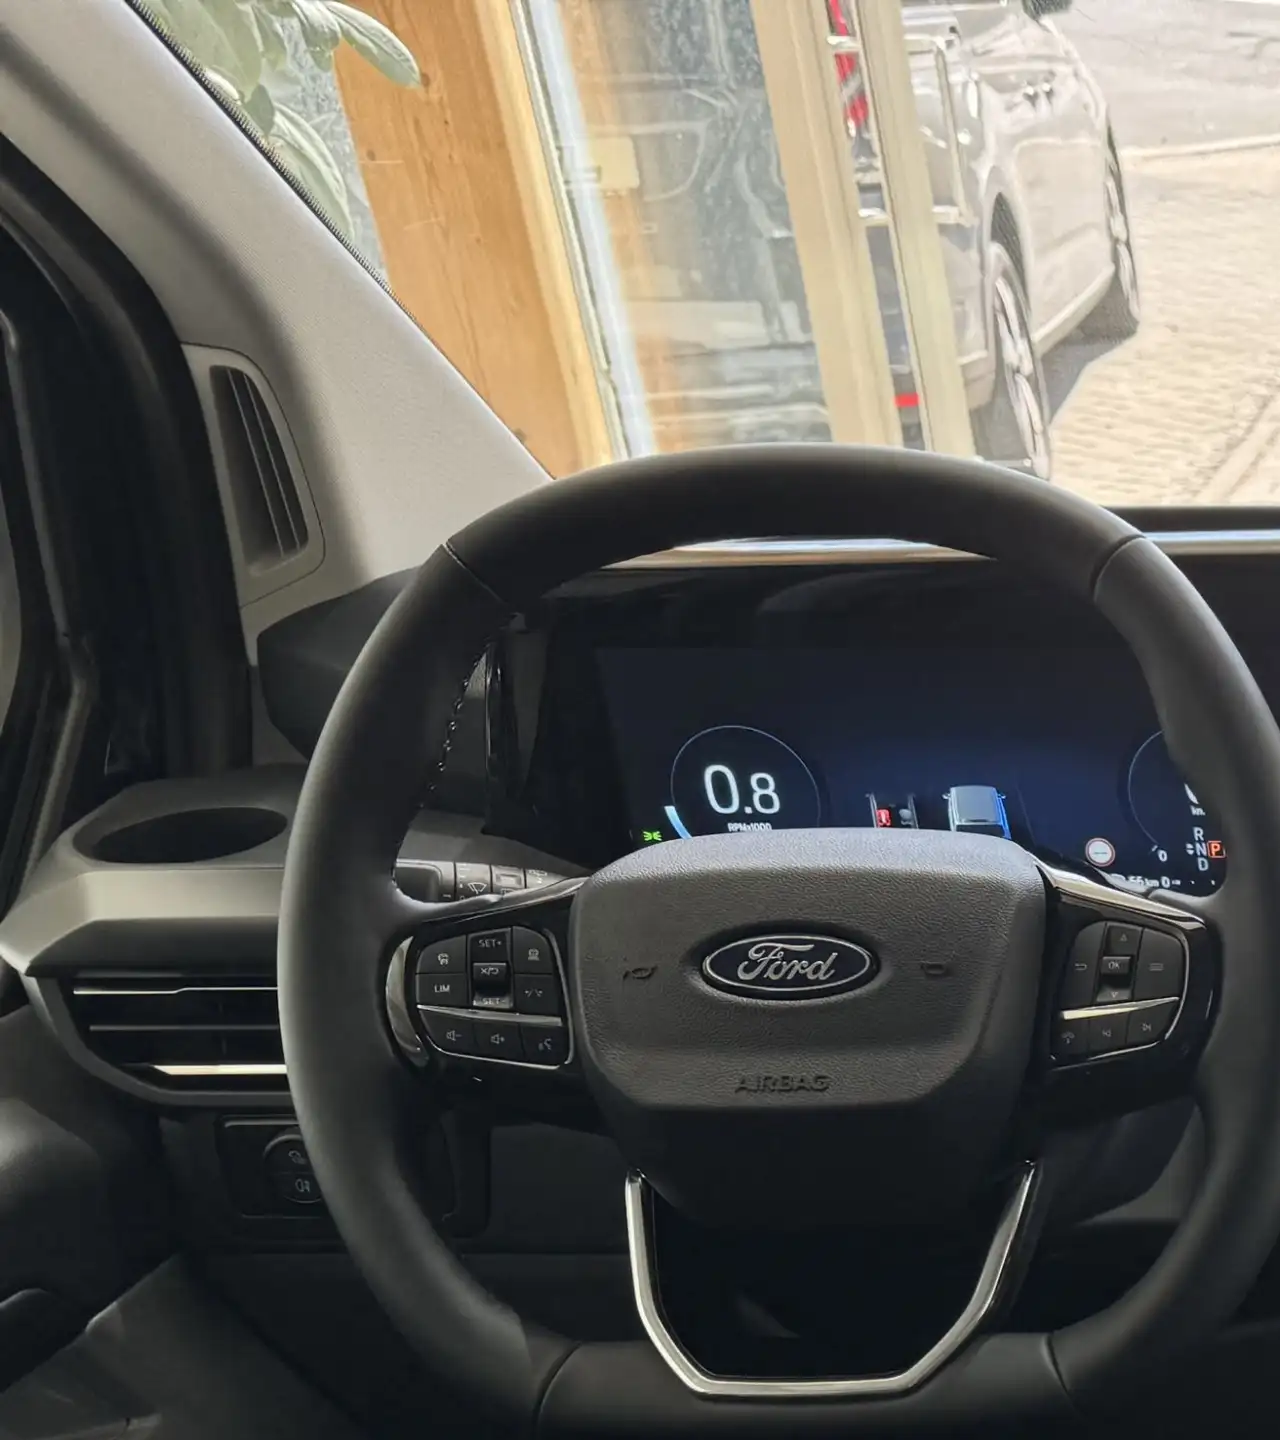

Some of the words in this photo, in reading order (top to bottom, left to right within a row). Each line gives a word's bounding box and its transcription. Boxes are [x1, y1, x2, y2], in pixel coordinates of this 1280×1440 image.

[703, 764, 781, 815] 0.8
[1193, 827, 1204, 841] R
[1158, 850, 1168, 861] 0
[1195, 842, 1208, 856] N
[1211, 843, 1221, 856] P
[1198, 857, 1209, 871] D
[737, 942, 838, 981] Ford
[1108, 961, 1121, 969] OK
[434, 985, 450, 993] LIM
[735, 1075, 833, 1093] AIRBAG
